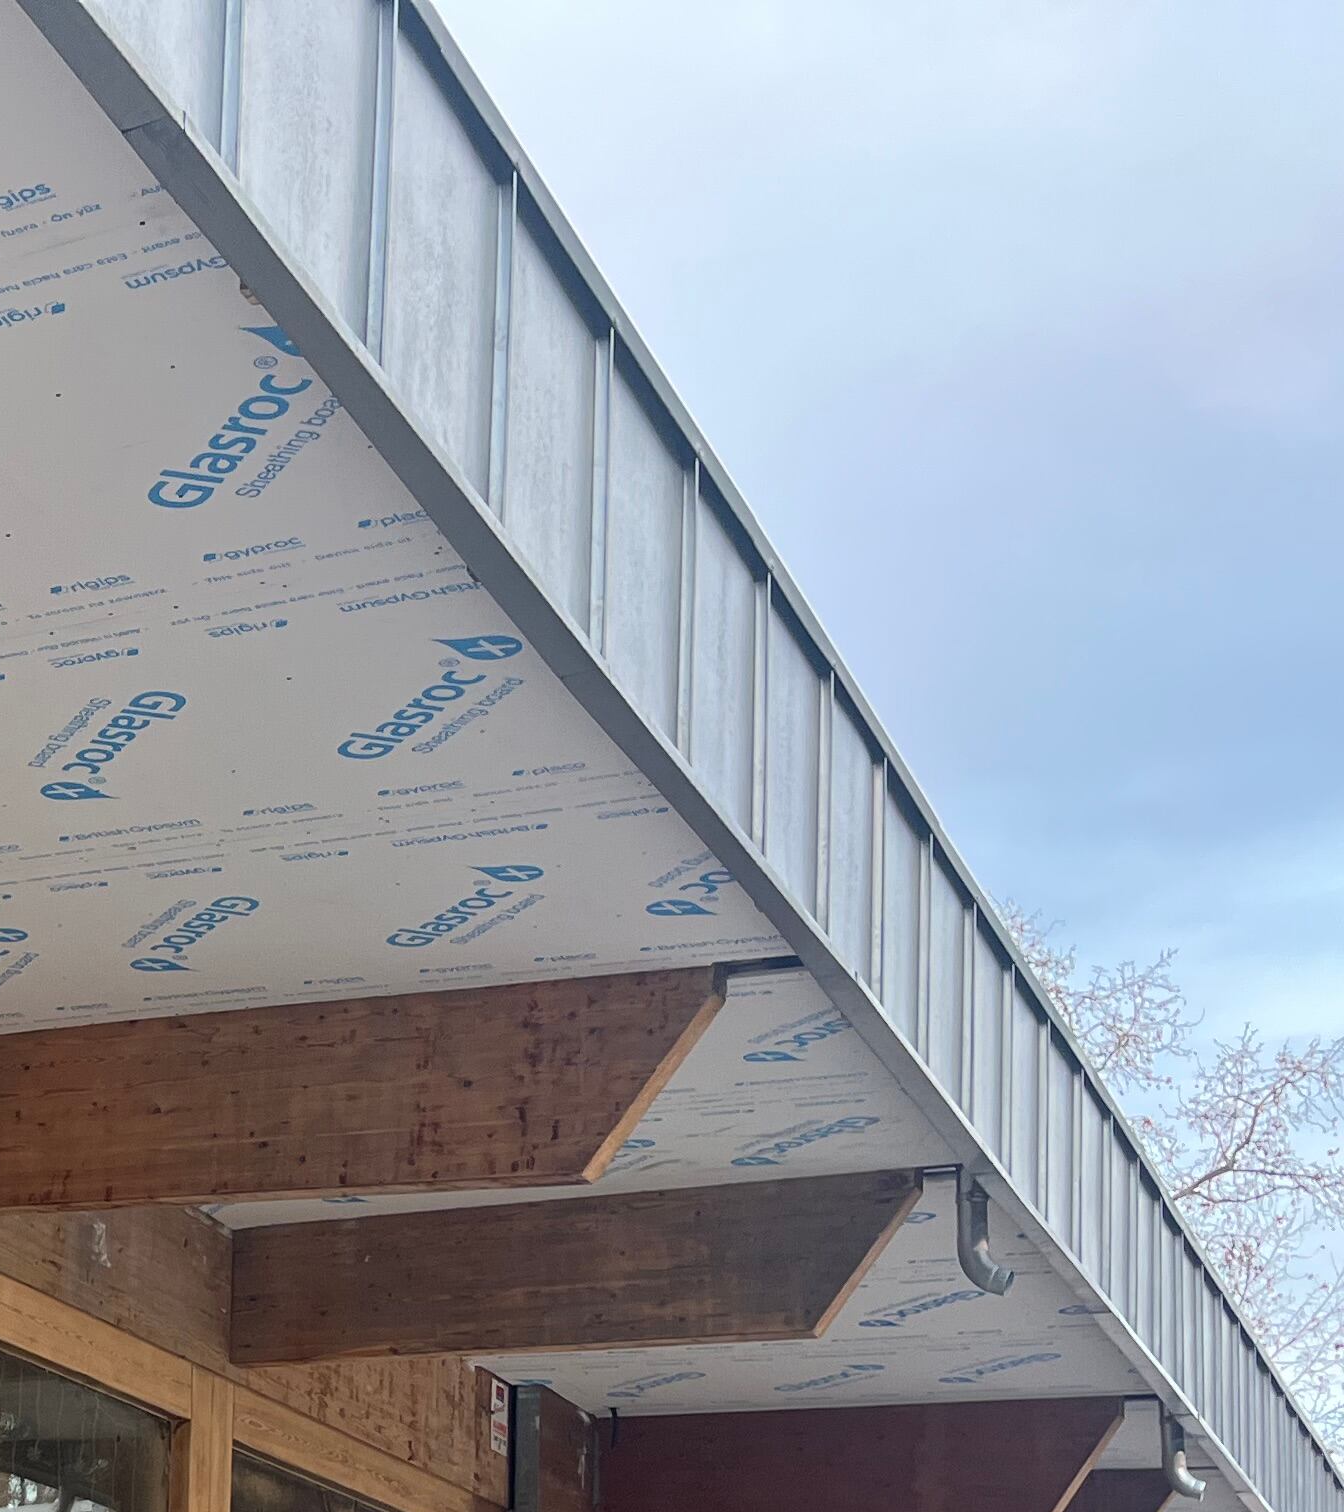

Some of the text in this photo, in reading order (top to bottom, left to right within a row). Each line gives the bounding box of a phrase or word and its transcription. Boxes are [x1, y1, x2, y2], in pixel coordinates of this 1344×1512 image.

[124, 255, 230, 289] Gypsum
[147, 373, 313, 508] Glasroc
[235, 395, 341, 498] Sheathing boa
[380, 510, 431, 528] plac
[224, 537, 303, 560] gyproc
[71, 574, 131, 593] rigips
[339, 590, 431, 614] Gypsum
[208, 621, 268, 638] rigips
[51, 649, 121, 669] gyproc
[337, 670, 488, 760] Glasroc
[412, 706, 489, 754] Sheathing
[62, 690, 187, 775] Glasroc
[150, 896, 260, 954] Glasroc
[386, 887, 513, 948] Glasroc
[774, 1017, 854, 1048] sroc
